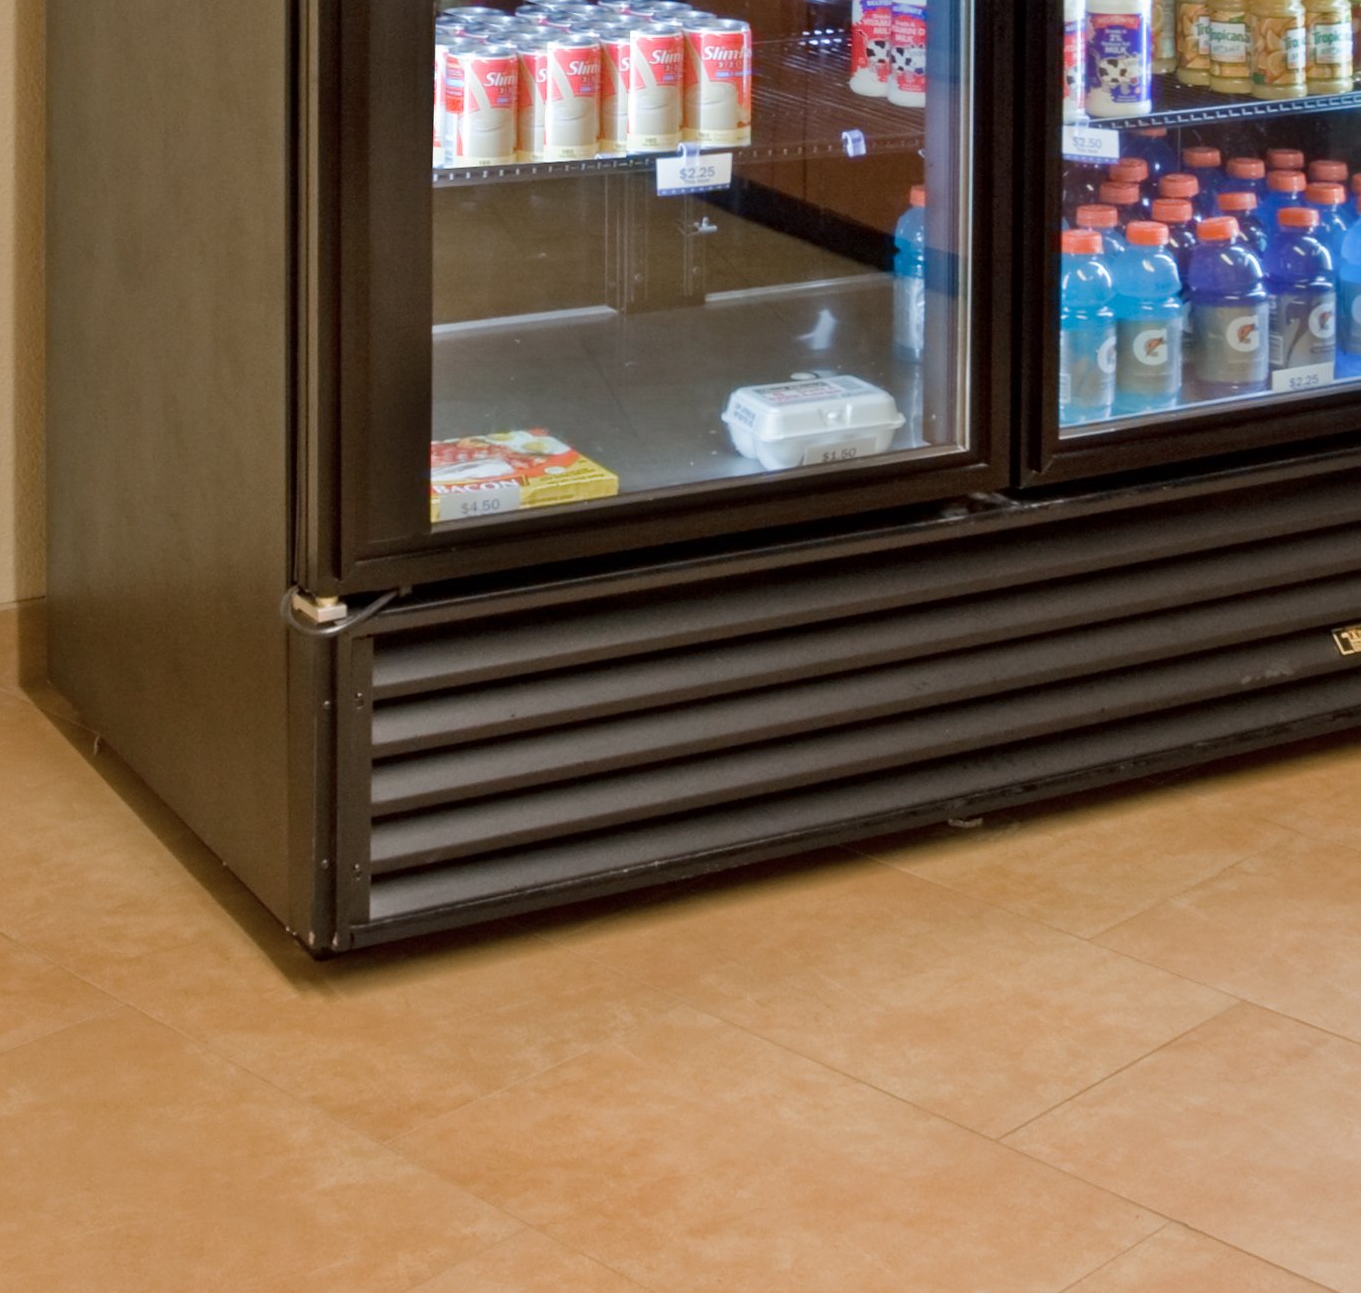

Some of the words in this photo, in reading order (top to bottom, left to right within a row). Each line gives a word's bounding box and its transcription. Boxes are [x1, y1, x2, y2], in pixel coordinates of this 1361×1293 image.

[679, 166, 715, 180] $2.25
[1226, 315, 1260, 352] G
[1133, 329, 1168, 366] G
[822, 447, 857, 463] $1.50
[433, 478, 520, 494] BACON
[461, 498, 501, 515] $4.50
